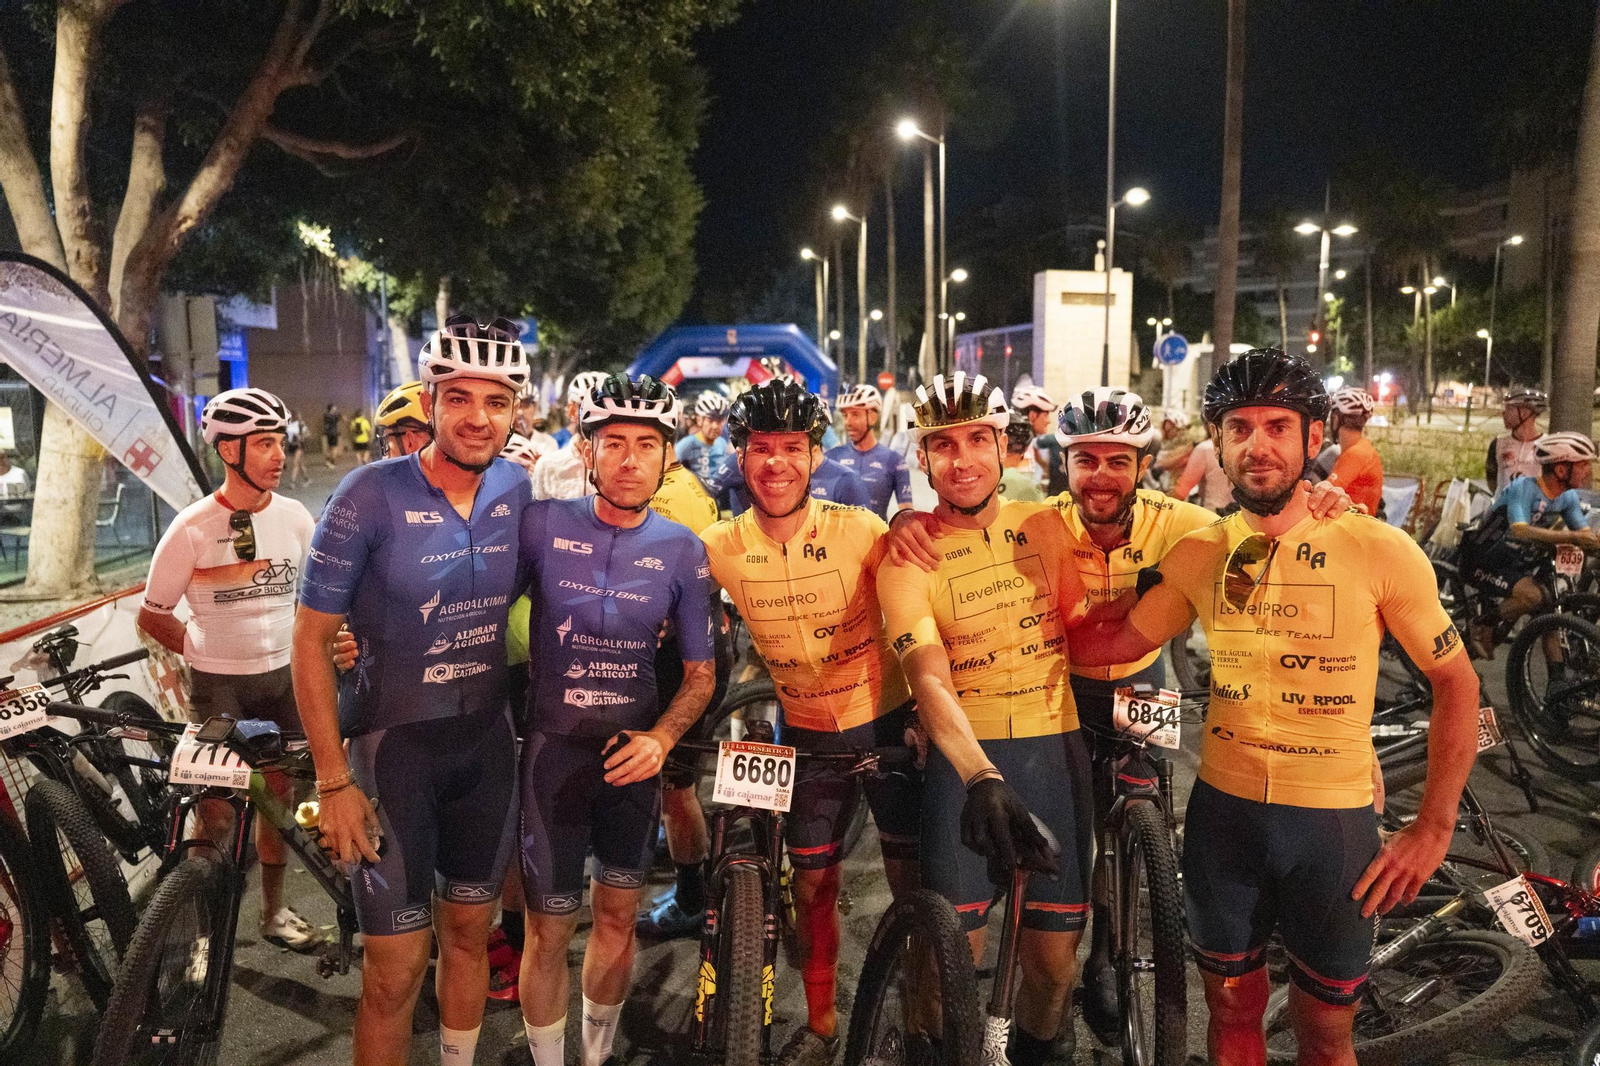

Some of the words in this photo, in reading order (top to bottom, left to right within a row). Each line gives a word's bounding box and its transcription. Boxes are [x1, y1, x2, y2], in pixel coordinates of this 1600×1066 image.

[482, 543, 511, 554] BIKE
[945, 546, 974, 561] GOBIK
[746, 555, 769, 564] GOBIK
[616, 591, 652, 603] BIKE
[959, 576, 1025, 604] LevelPRO
[438, 595, 508, 616] AGROALKIMIA
[750, 592, 818, 609] LevelPRO
[572, 633, 647, 650] AGROALKIMIA
[1255, 627, 1281, 637] BIKE
[1285, 629, 1322, 641] TEAM
[0, 691, 51, 721] 6358
[1127, 699, 1179, 730] 6844
[194, 772, 231, 783] cajamar
[732, 754, 792, 788] 6680
[736, 790, 773, 802] cajamar
[1509, 890, 1548, 940] 6709
